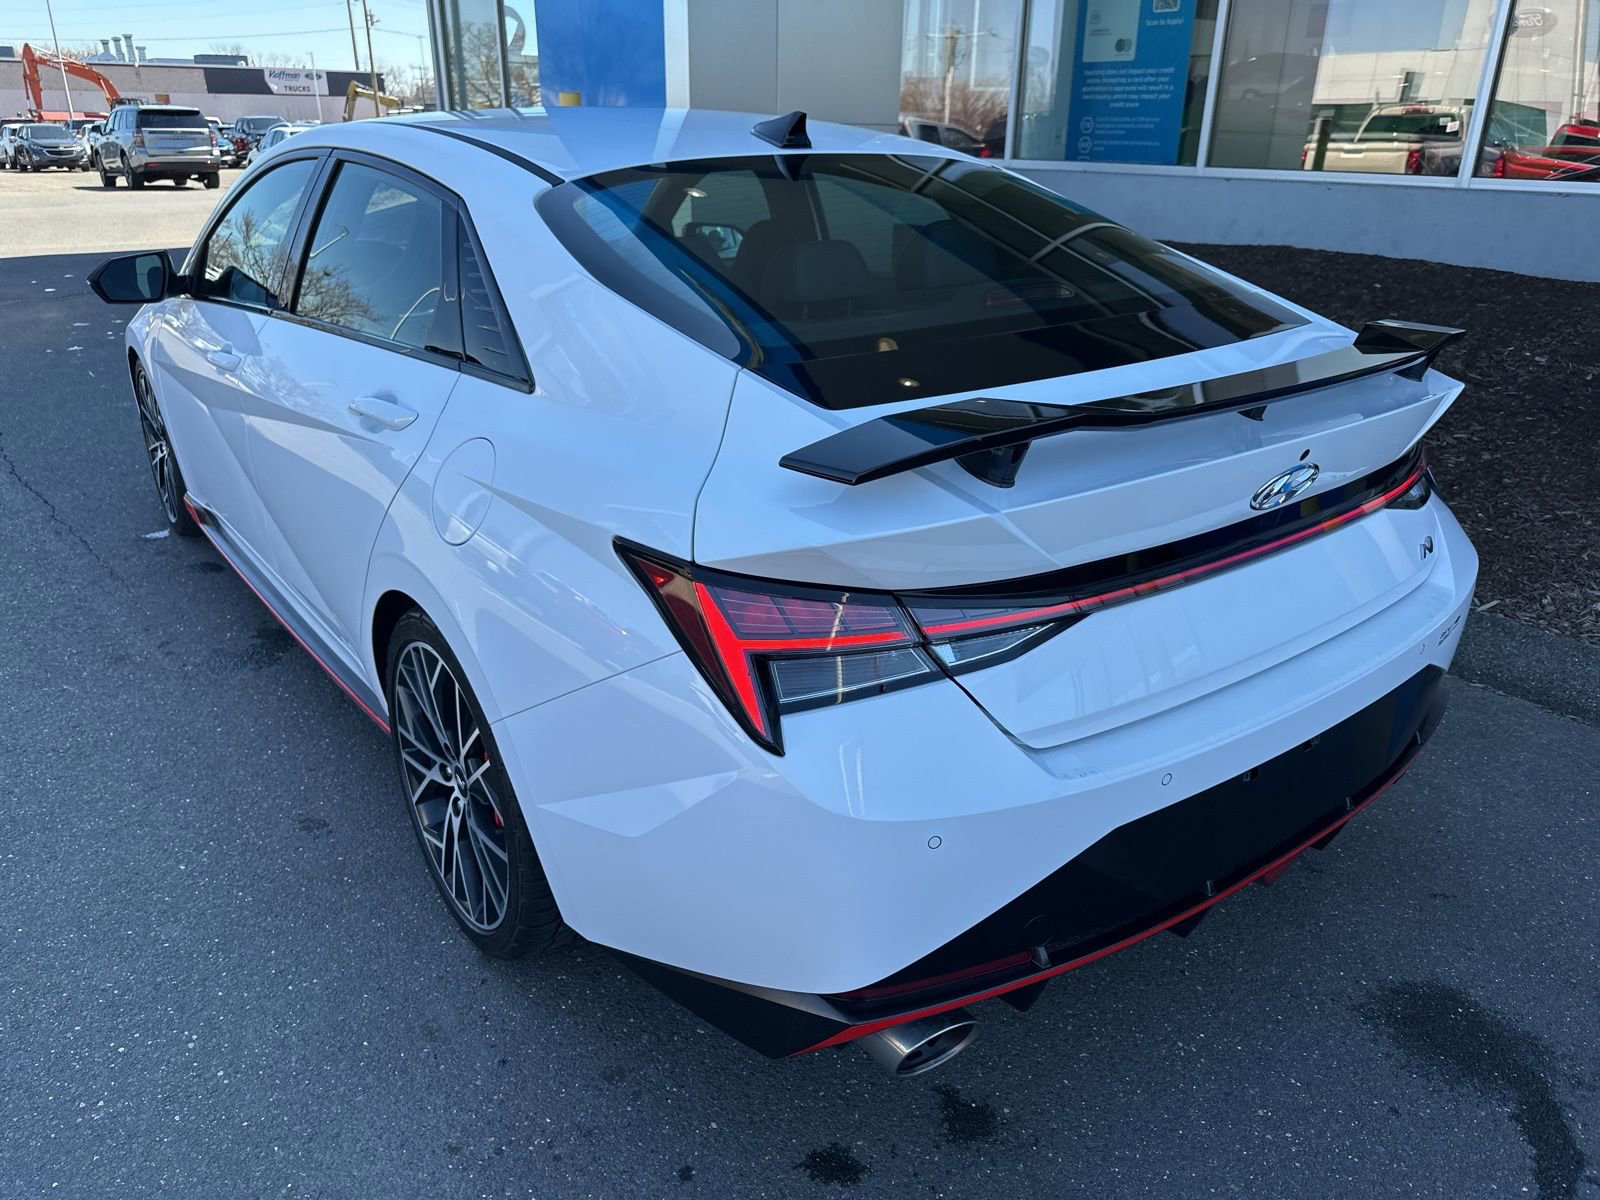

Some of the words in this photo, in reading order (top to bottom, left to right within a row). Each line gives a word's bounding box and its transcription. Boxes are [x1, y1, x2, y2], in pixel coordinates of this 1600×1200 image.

[1160, 18, 1166, 26] to
[284, 85, 311, 93] TRUCKS
[1419, 535, 1434, 560] N
